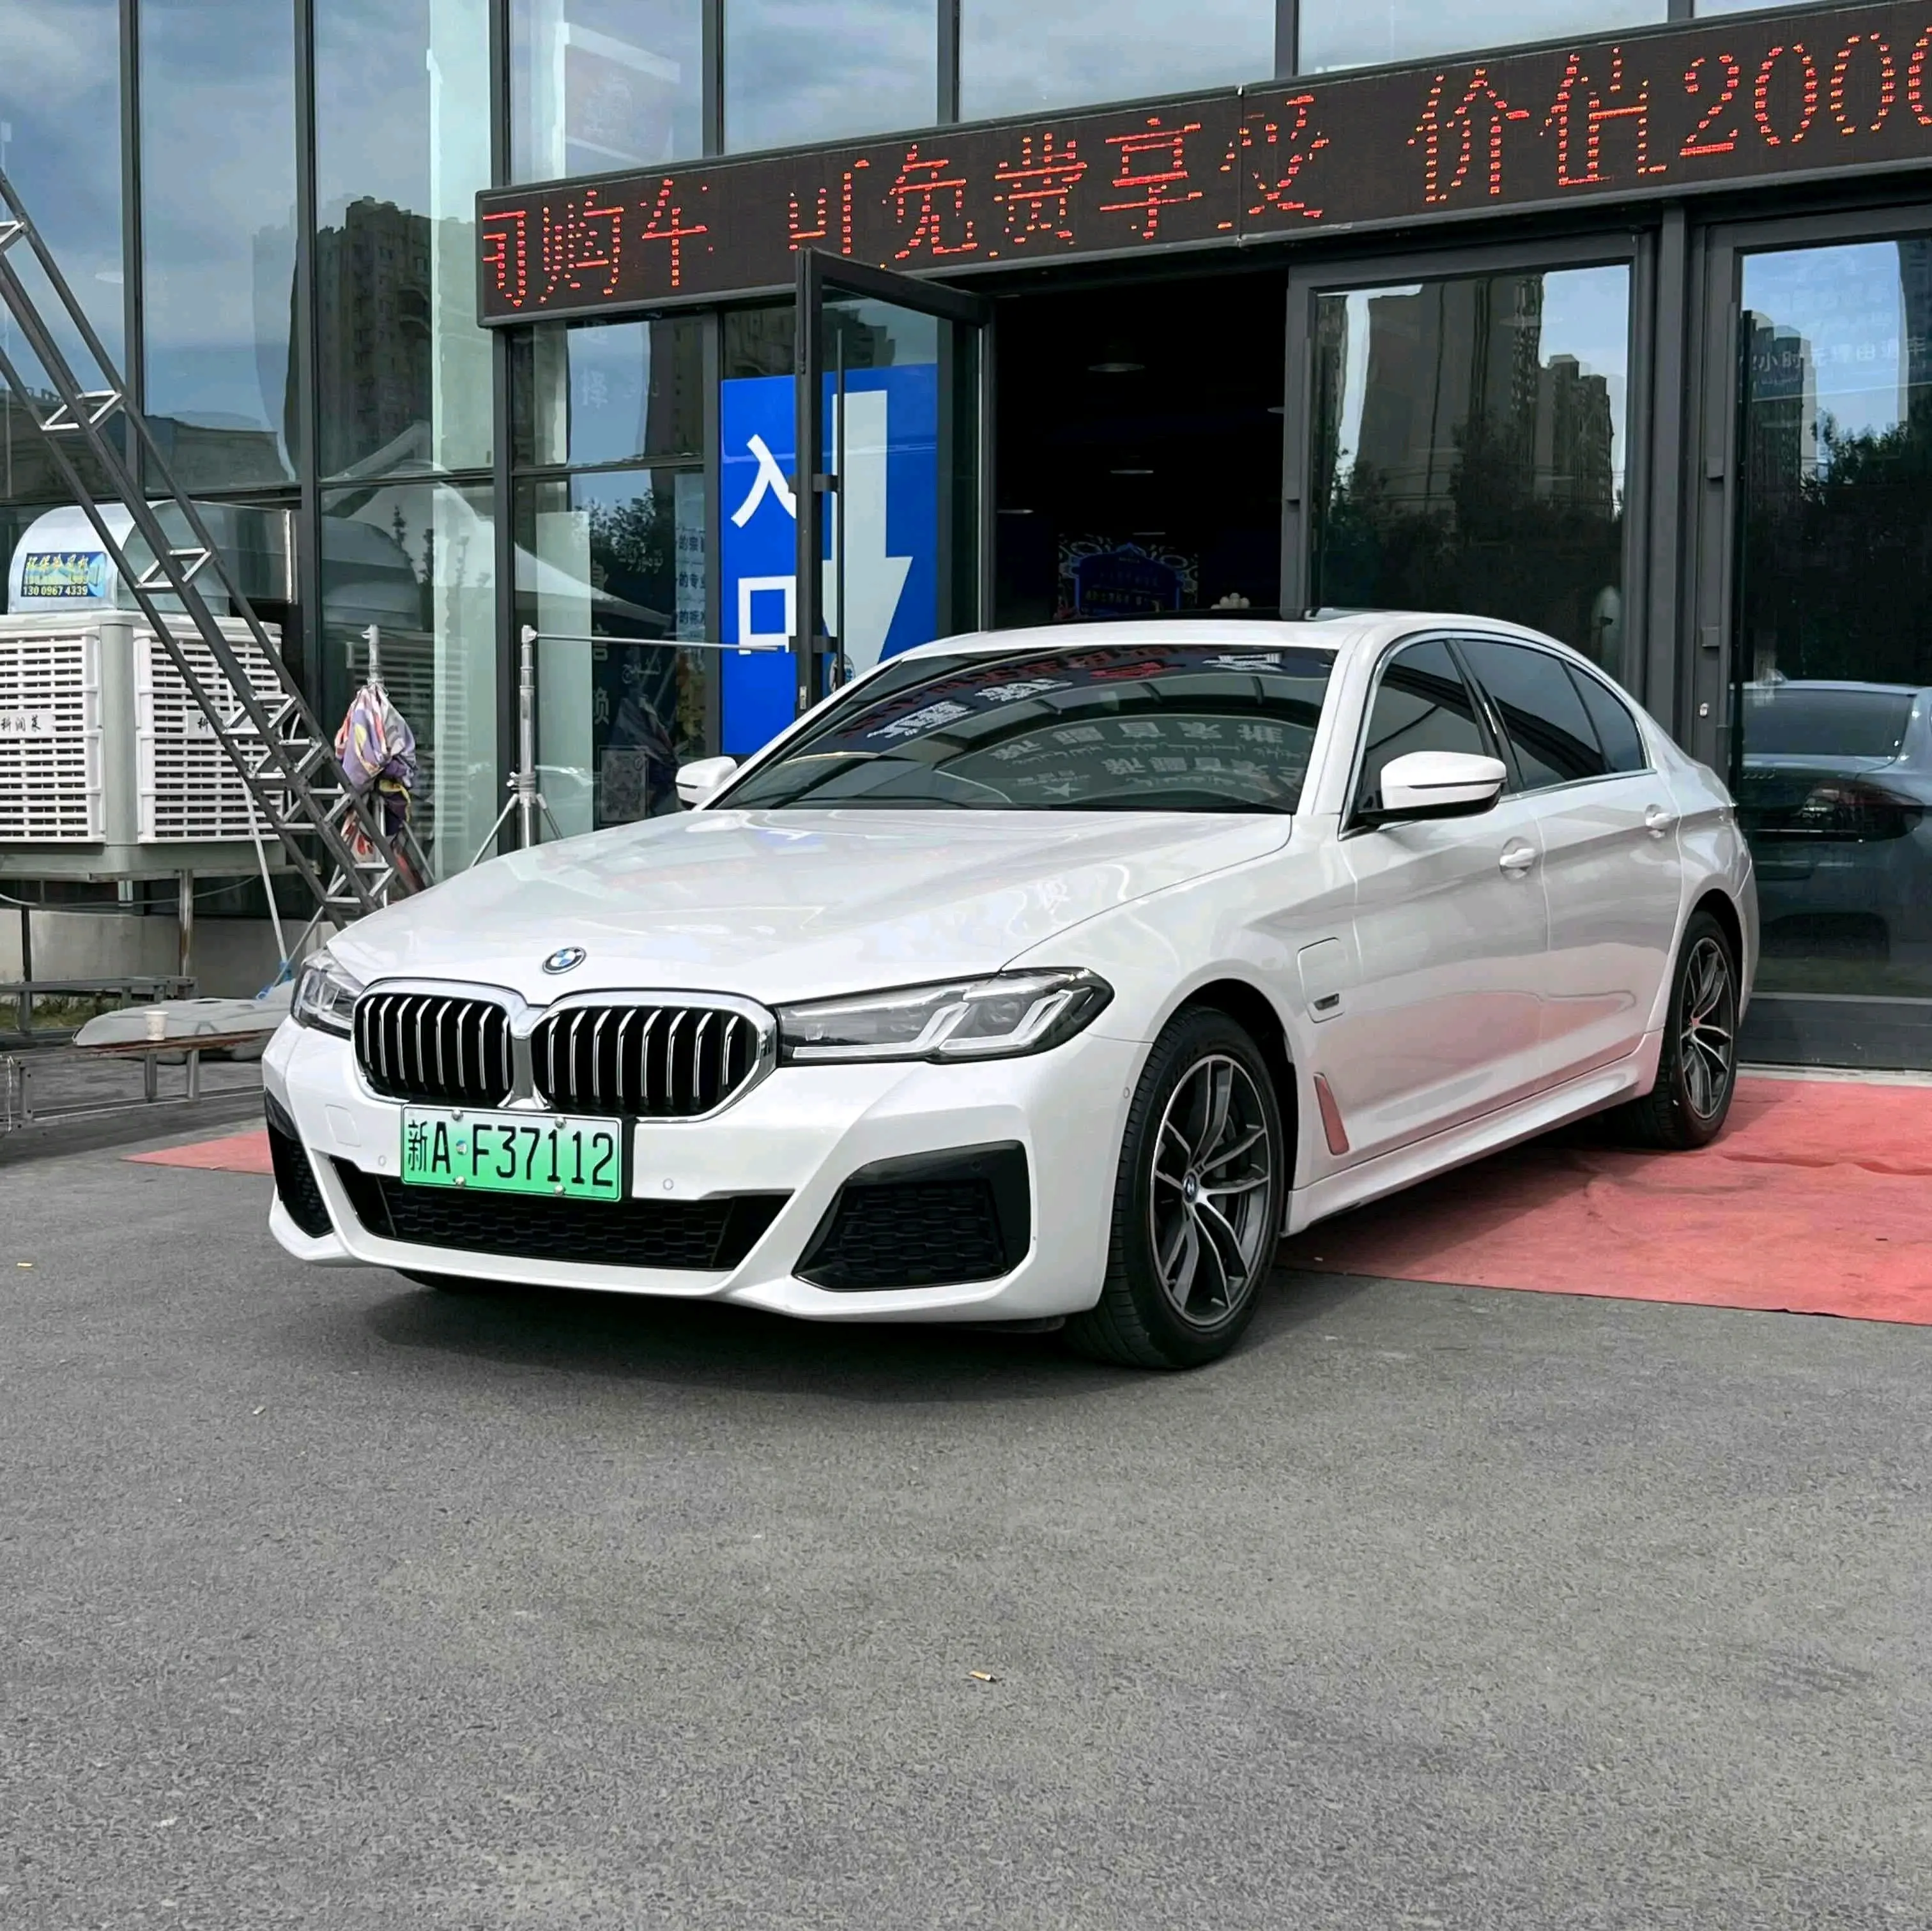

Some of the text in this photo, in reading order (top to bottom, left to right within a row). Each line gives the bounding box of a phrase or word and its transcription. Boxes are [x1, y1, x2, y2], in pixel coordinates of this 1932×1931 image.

[23, 585, 88, 595] 130 0967 4339
[731, 434, 796, 655] 入口
